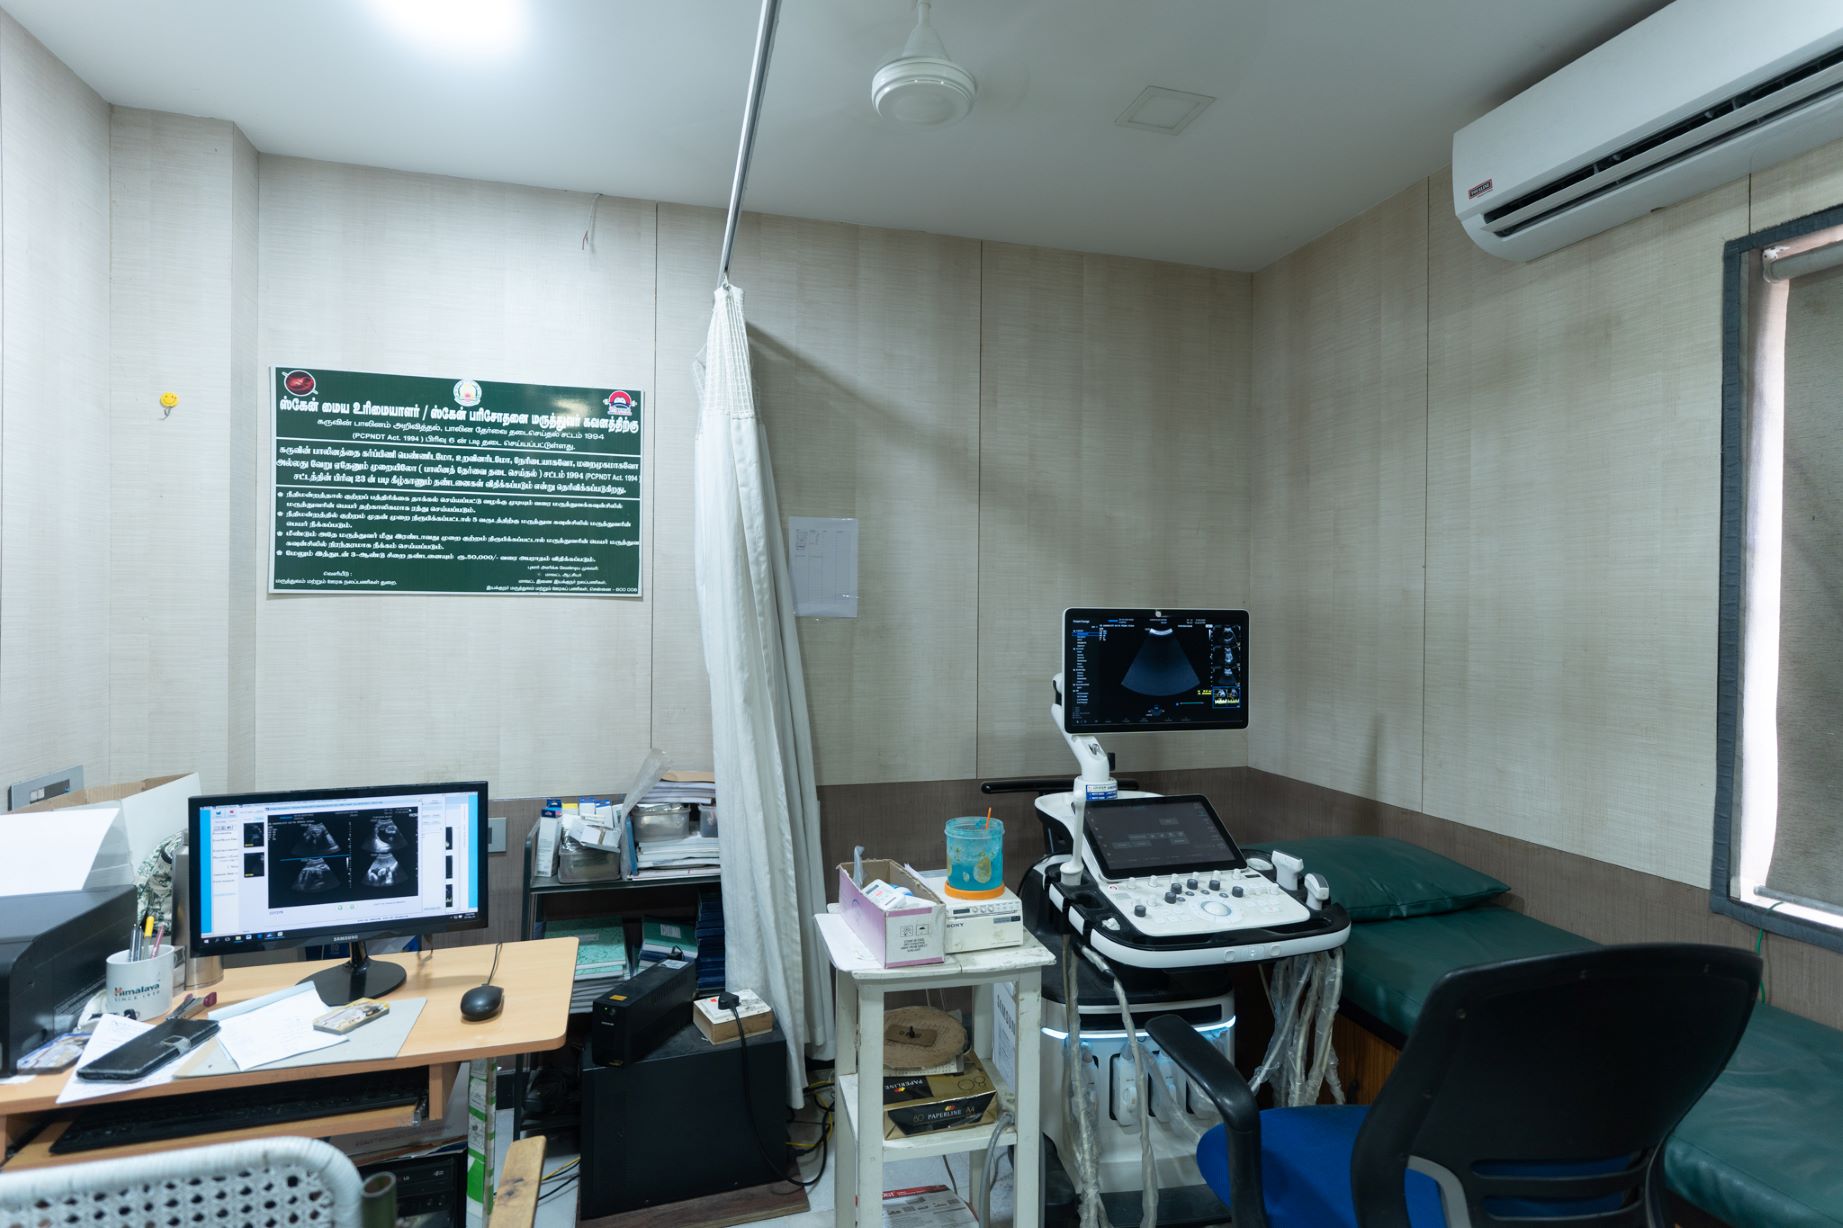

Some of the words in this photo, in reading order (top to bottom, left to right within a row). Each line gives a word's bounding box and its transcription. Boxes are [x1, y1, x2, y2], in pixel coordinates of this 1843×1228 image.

[279, 395, 318, 412] ஸ்கேன்
[321, 402, 350, 414] மைய
[352, 400, 419, 417] உரிமையாளர்
[430, 405, 467, 420] ஸ்கேன்
[469, 407, 528, 426] பரிசோதனை
[531, 413, 581, 431] மருத்துவர்
[583, 416, 639, 433] கவனத்திற்கு
[317, 418, 352, 426] கருவின்
[353, 419, 391, 428] பாலினம்
[444, 424, 473, 432] பாலின
[474, 426, 508, 435] தேர்வை
[509, 428, 560, 438] தடைசெய்தல்
[560, 430, 583, 439] சட்டம்
[424, 434, 447, 444] பிரிவு
[354, 474, 366, 482] 23
[566, 471, 583, 479] 1994
[584, 472, 611, 480] (PCPNDT
[114, 984, 160, 996] Himalaya
[884, 1079, 924, 1090] PAPERLINE
[928, 1110, 961, 1119] PAPERLINE
